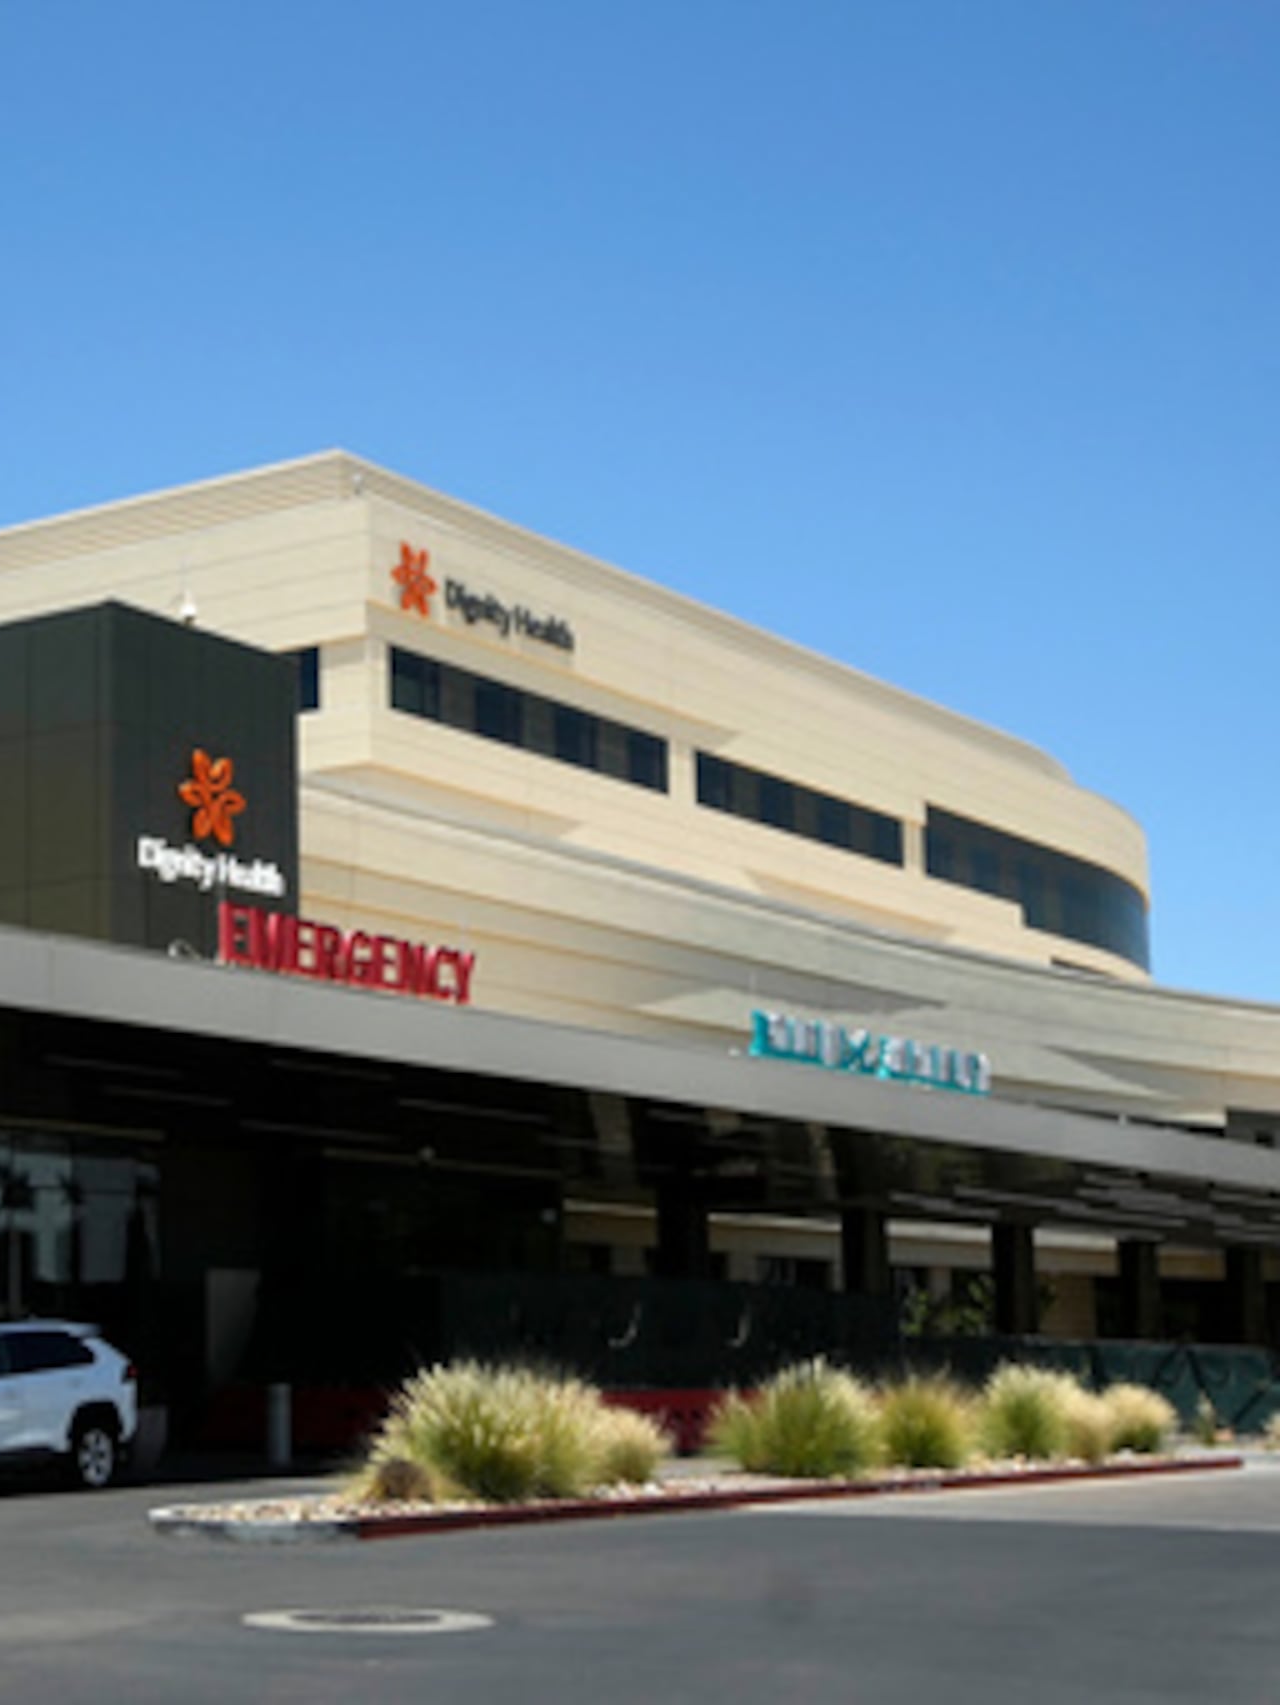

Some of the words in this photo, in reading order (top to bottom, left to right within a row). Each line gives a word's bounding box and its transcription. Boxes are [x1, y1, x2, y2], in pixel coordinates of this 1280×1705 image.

[445, 578, 510, 637] Dignity
[515, 605, 575, 651] Health
[137, 837, 215, 891] Dignity
[218, 853, 285, 897] Health
[218, 902, 474, 1004] EMERGENCY
